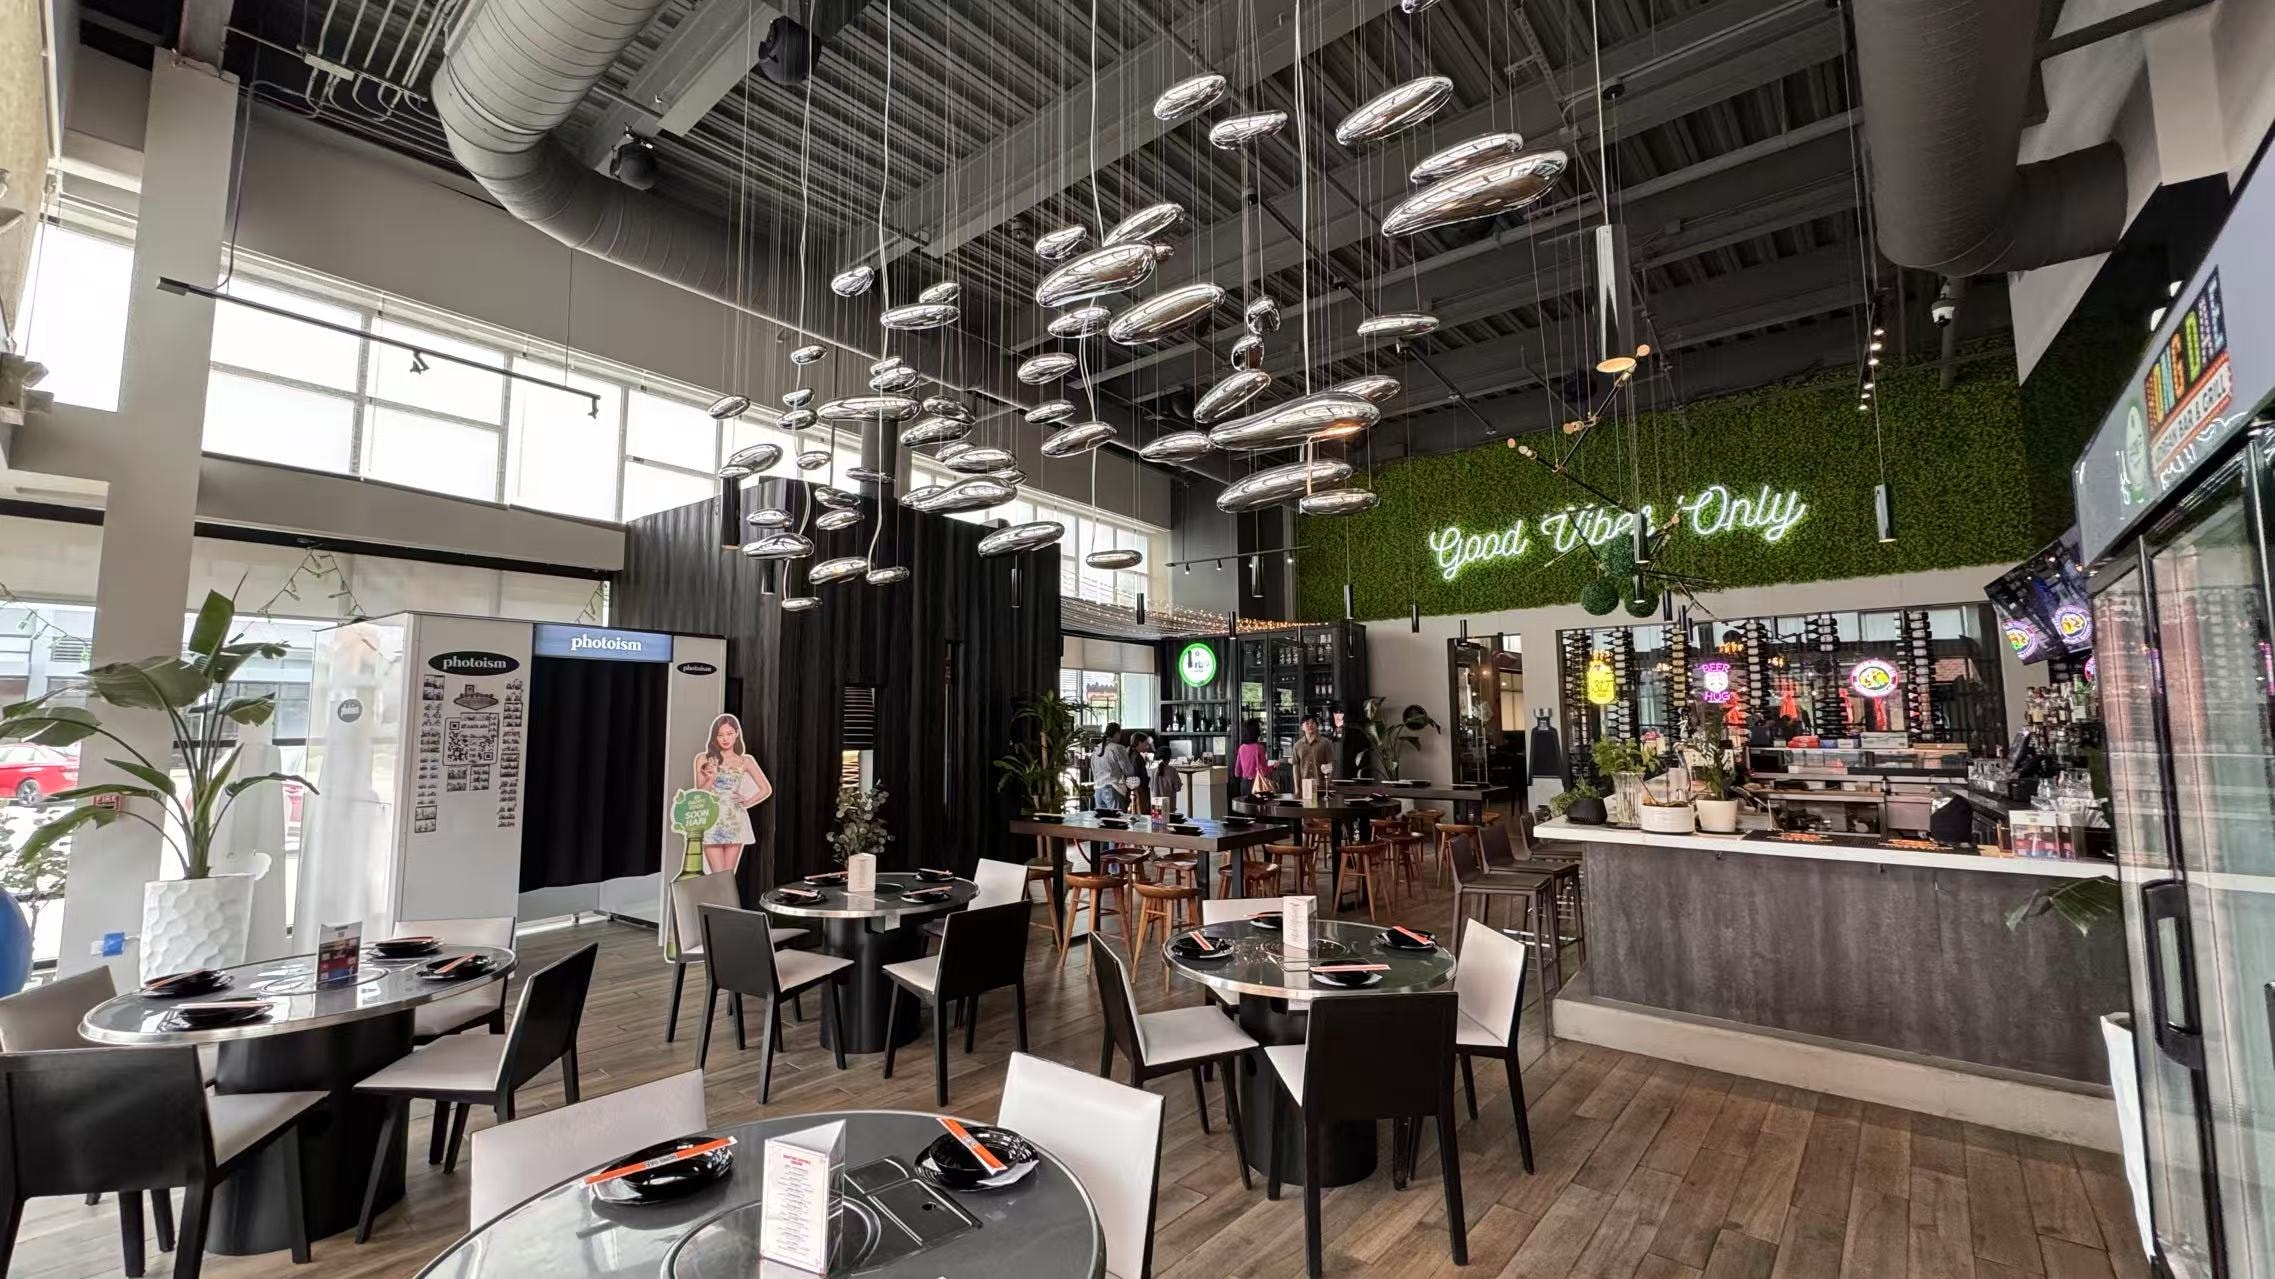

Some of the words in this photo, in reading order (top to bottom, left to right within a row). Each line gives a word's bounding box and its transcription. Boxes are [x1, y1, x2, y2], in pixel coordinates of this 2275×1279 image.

[1429, 521, 1529, 581] Good
[1680, 485, 1806, 542] Only
[571, 634, 642, 651] photoism
[443, 656, 506, 670] photoism
[1702, 663, 1730, 673] BEER
[1704, 692, 1730, 701] HUG
[684, 809, 709, 819] SOON
